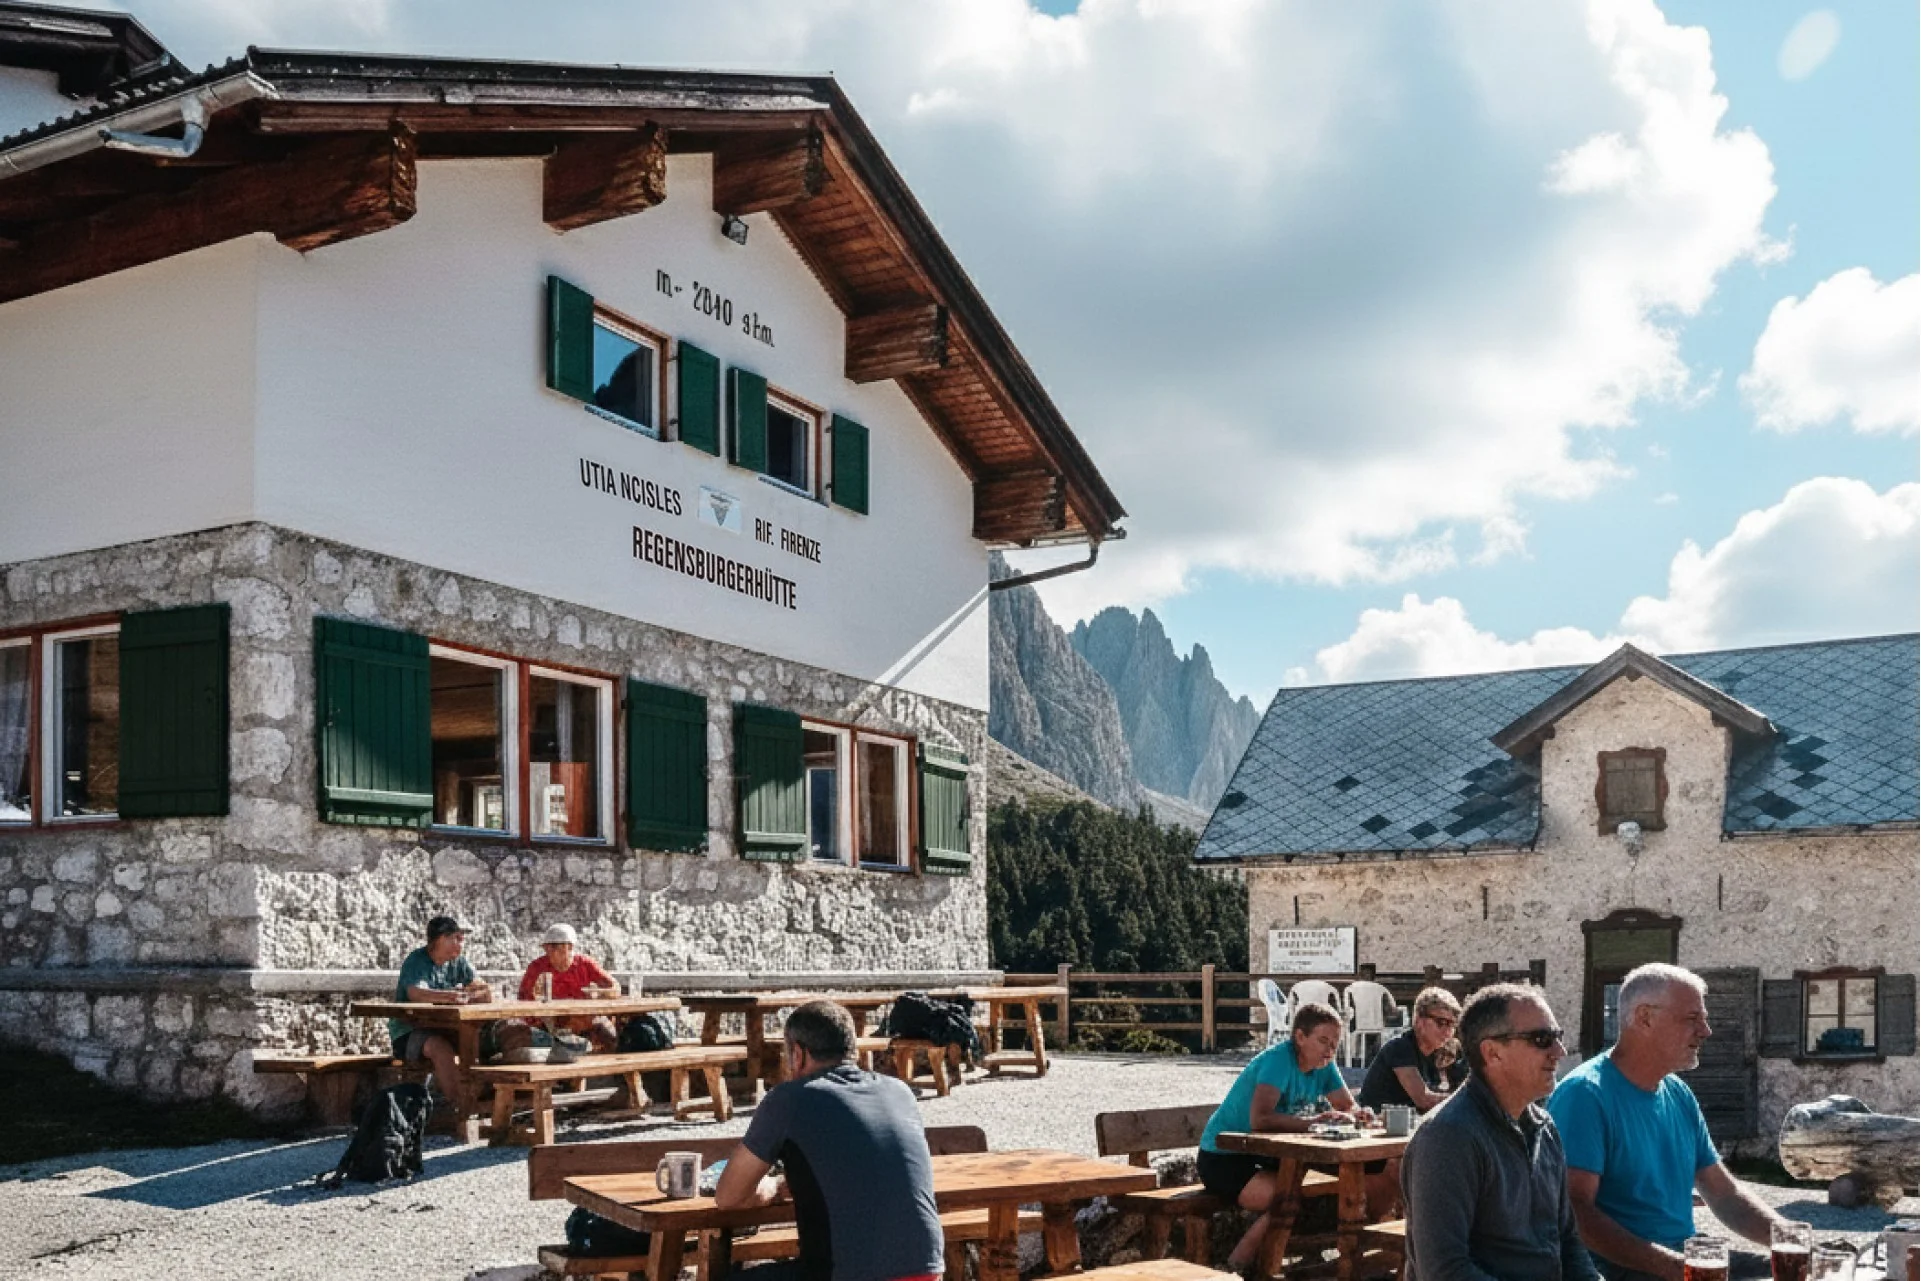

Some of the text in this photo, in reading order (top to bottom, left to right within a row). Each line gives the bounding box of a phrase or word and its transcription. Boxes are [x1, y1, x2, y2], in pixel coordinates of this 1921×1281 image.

[579, 458, 682, 516] UTIA NCISLES
[632, 526, 797, 610] REGENSBURGERHÜTTE
[755, 518, 821, 563] RIF. FIRENZE
